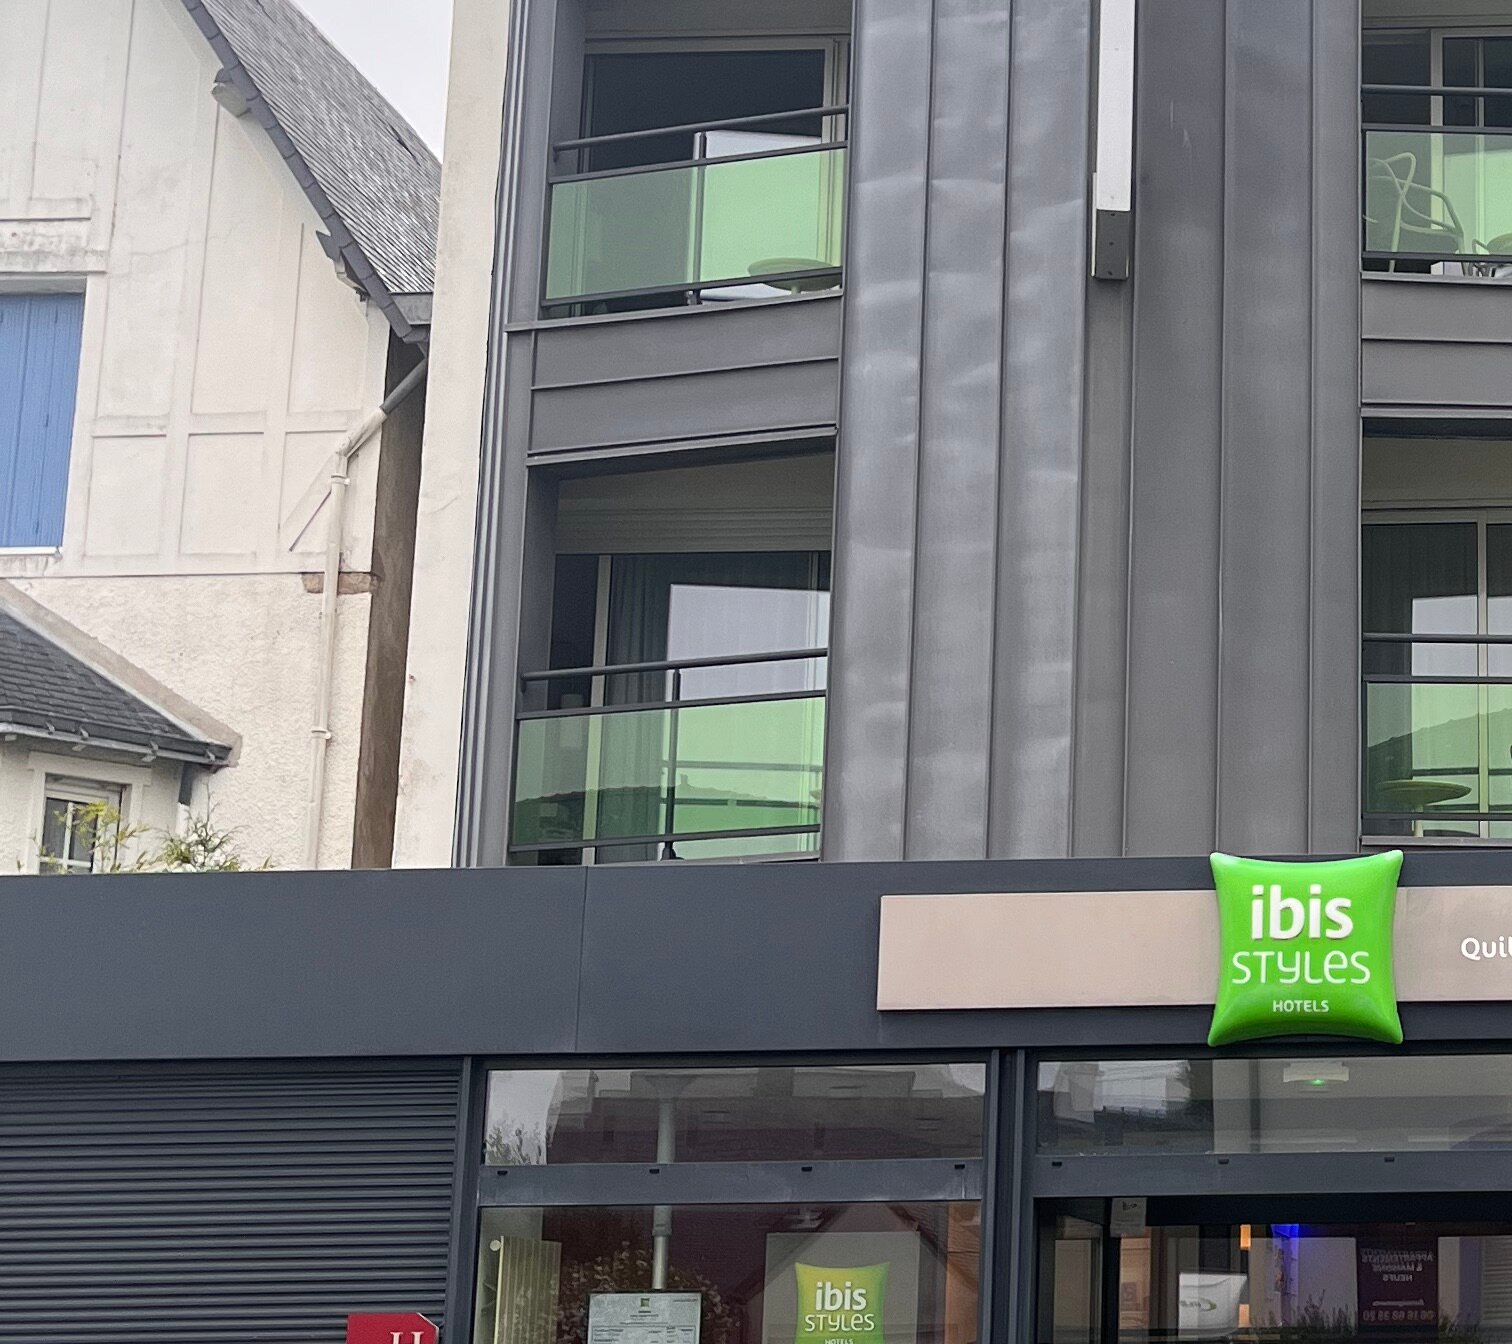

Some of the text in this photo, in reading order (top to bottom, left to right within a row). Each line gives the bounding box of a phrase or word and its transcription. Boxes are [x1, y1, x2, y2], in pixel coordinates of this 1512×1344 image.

[1251, 884, 1354, 940] ibis
[1273, 1000, 1329, 1013] HOTELS
[815, 1281, 867, 1311] ibis
